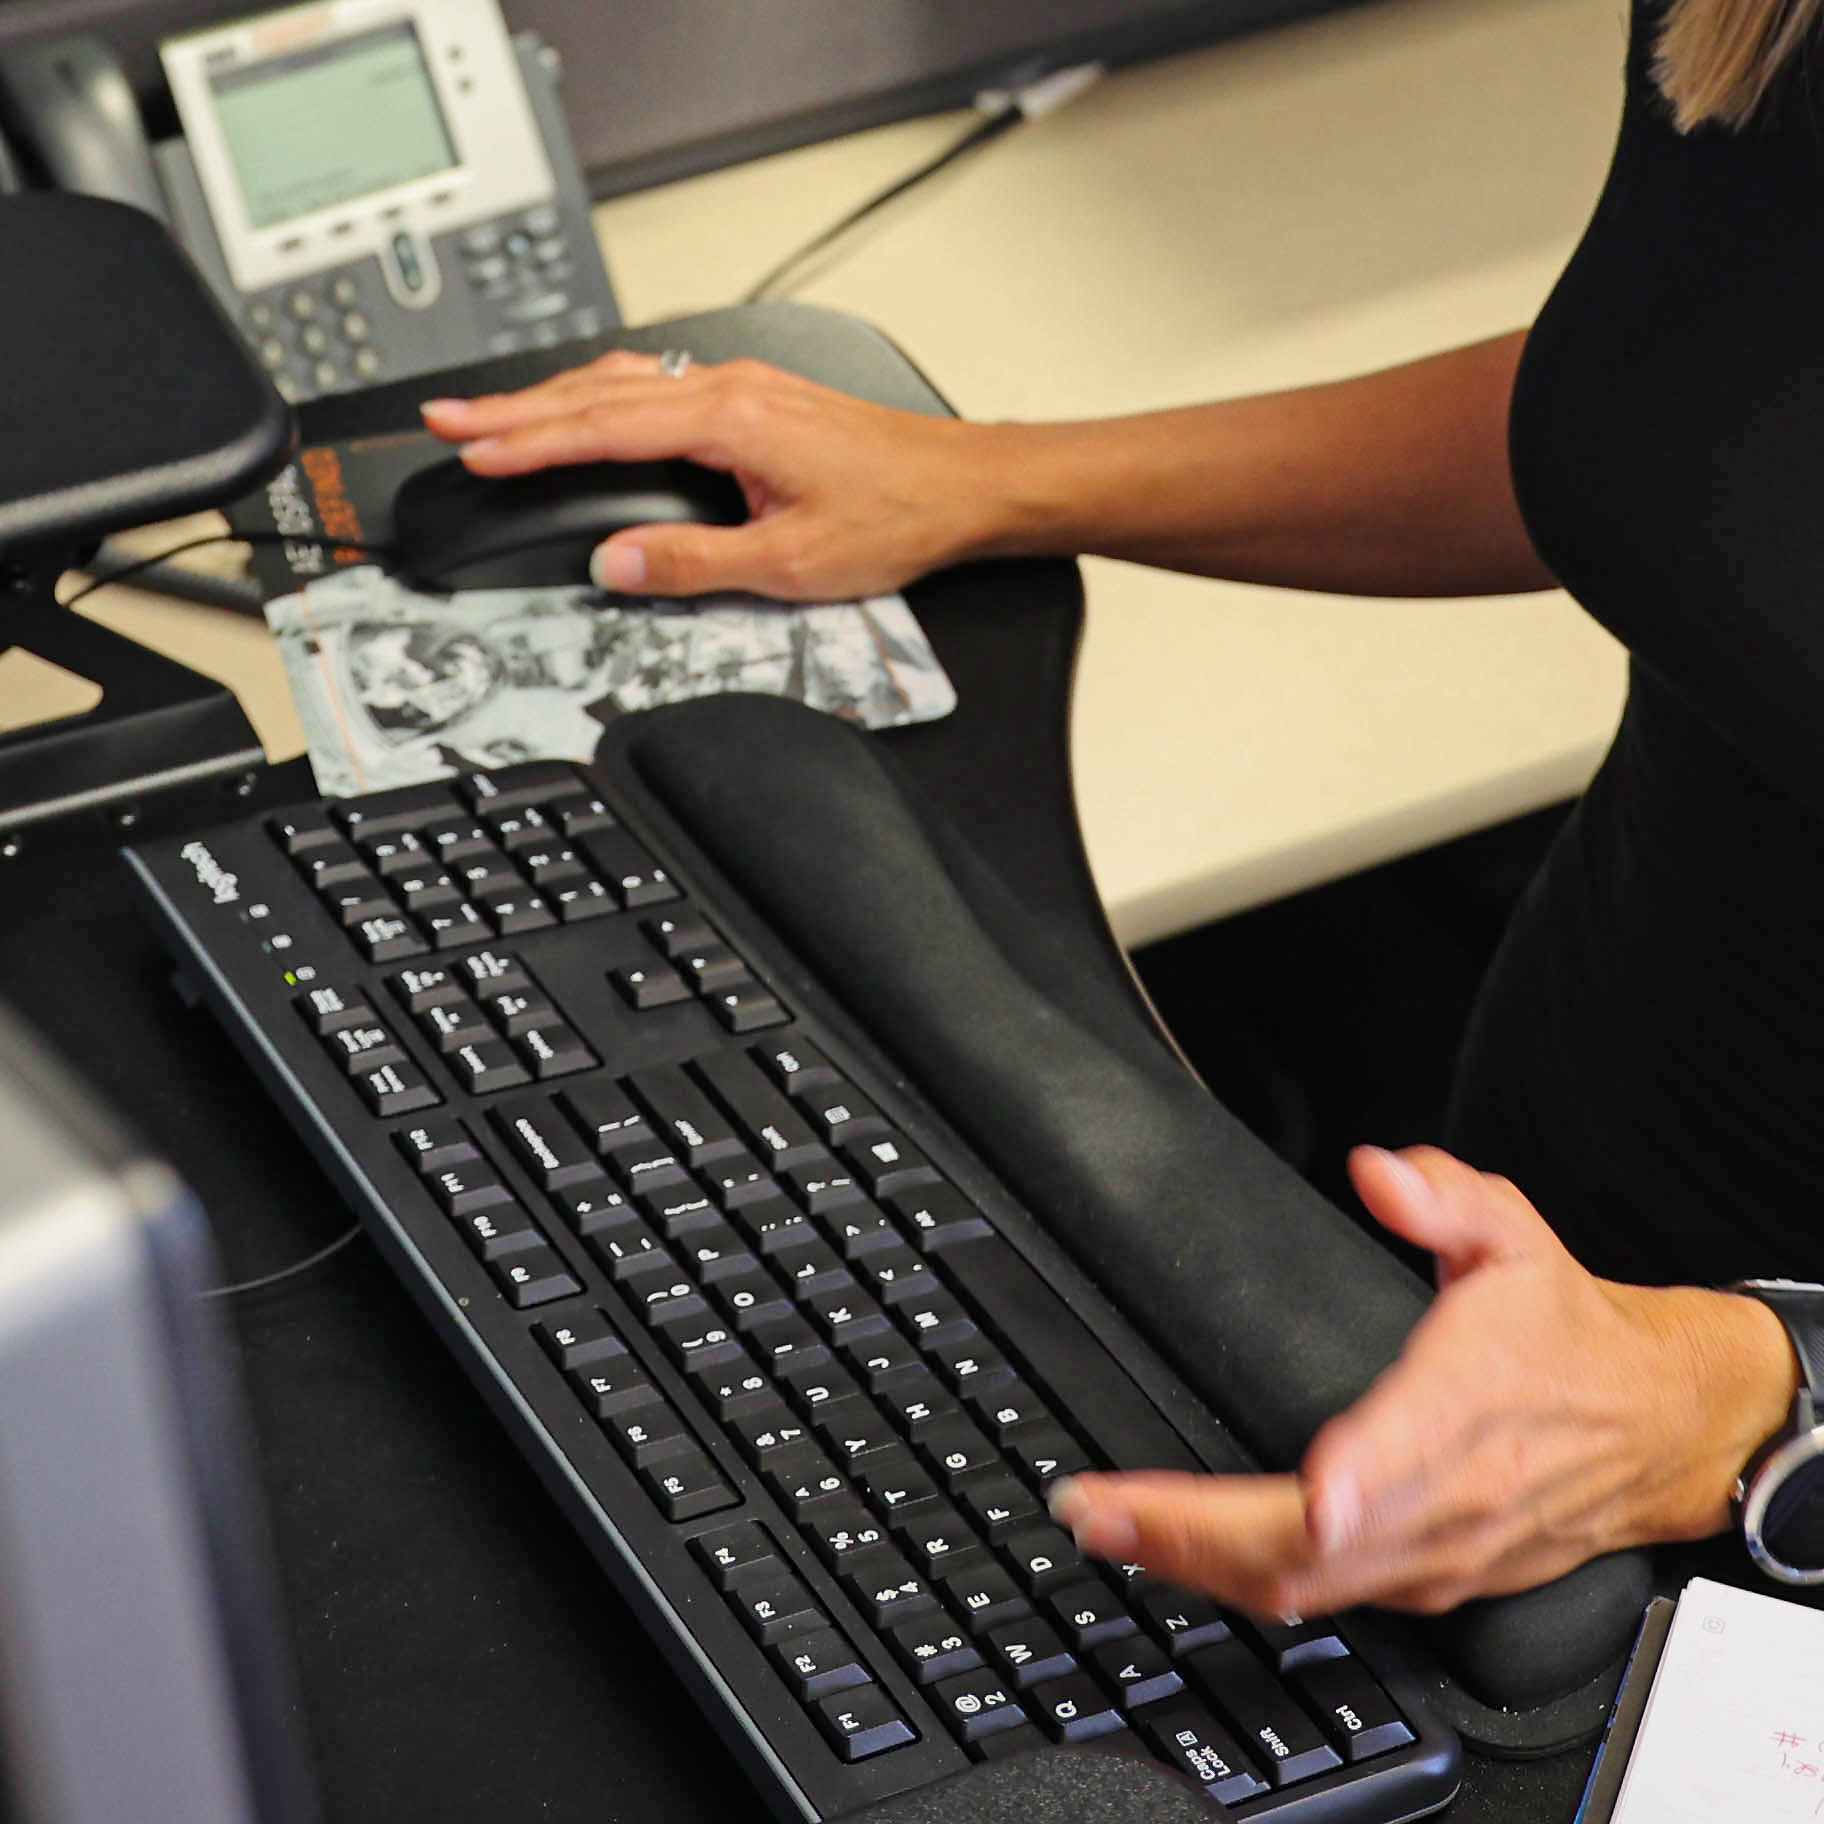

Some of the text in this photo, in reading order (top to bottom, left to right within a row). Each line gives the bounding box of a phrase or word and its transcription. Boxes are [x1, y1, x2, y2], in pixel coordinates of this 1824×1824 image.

[410, 1129, 436, 1153] F12
[441, 1173, 464, 1192] F11
[474, 1216, 496, 1237] F10
[698, 1249, 719, 1261] P
[511, 1268, 529, 1282] F9
[798, 1264, 815, 1277] L
[671, 1285, 689, 1296] 0
[734, 1293, 754, 1306] O
[829, 1308, 851, 1323] K
[915, 1312, 938, 1328] M
[556, 1330, 575, 1344] F8
[706, 1331, 725, 1342] 9
[775, 1345, 792, 1353] I
[868, 1358, 889, 1368] J
[956, 1360, 978, 1374] N
[591, 1379, 610, 1392] F7
[743, 1377, 762, 1389] 8
[806, 1387, 828, 1401] U
[906, 1404, 929, 1419] H
[997, 1409, 1018, 1422] B
[628, 1426, 647, 1442] F6
[780, 1430, 800, 1440] 7
[845, 1440, 868, 1453] Y
[946, 1454, 966, 1468] G
[1036, 1461, 1056, 1473] V
[664, 1478, 683, 1493] F5
[820, 1478, 839, 1490] 6
[885, 1491, 905, 1503] T
[987, 1509, 1009, 1520] F
[830, 1532, 853, 1549] %
[858, 1531, 878, 1542] 5
[927, 1539, 948, 1553] R
[715, 1548, 735, 1564] F4
[1031, 1557, 1052, 1572] D
[876, 1586, 901, 1601] $
[897, 1582, 918, 1593] 4
[968, 1593, 990, 1608] E
[755, 1601, 775, 1618] F3
[1075, 1611, 1095, 1624] S
[1166, 1616, 1188, 1629] Z
[942, 1637, 961, 1649] 3
[1005, 1645, 1032, 1663] W
[795, 1655, 816, 1672] F2
[1120, 1665, 1141, 1678] A
[955, 1695, 981, 1712] @
[985, 1692, 1005, 1704] 2
[1056, 1701, 1076, 1717] Q
[838, 1713, 859, 1729] F1
[1336, 1705, 1362, 1730] Ctrl
[1260, 1727, 1289, 1756] Shift
[1186, 1747, 1218, 1779] Caps
[1200, 1745, 1230, 1777] Lock
